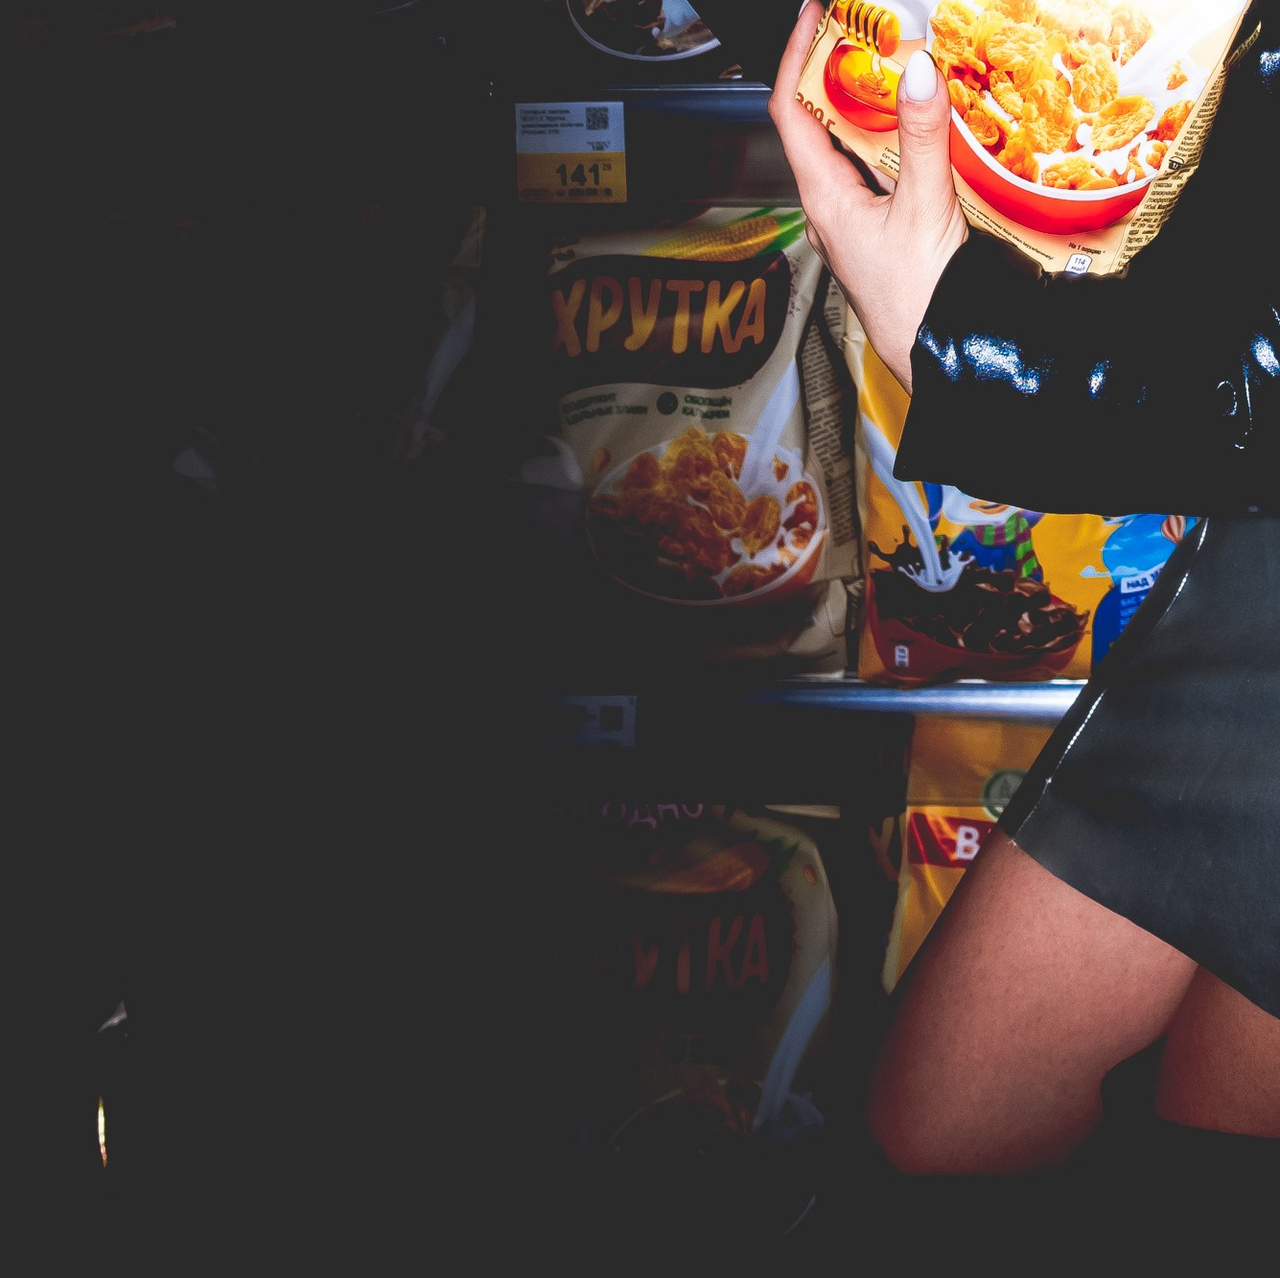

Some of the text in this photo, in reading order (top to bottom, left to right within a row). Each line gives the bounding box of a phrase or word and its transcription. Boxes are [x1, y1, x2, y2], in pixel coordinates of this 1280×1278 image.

[556, 164, 599, 186] 141
[1074, 256, 1086, 266] 114
[551, 276, 767, 358] ХРУТКА
